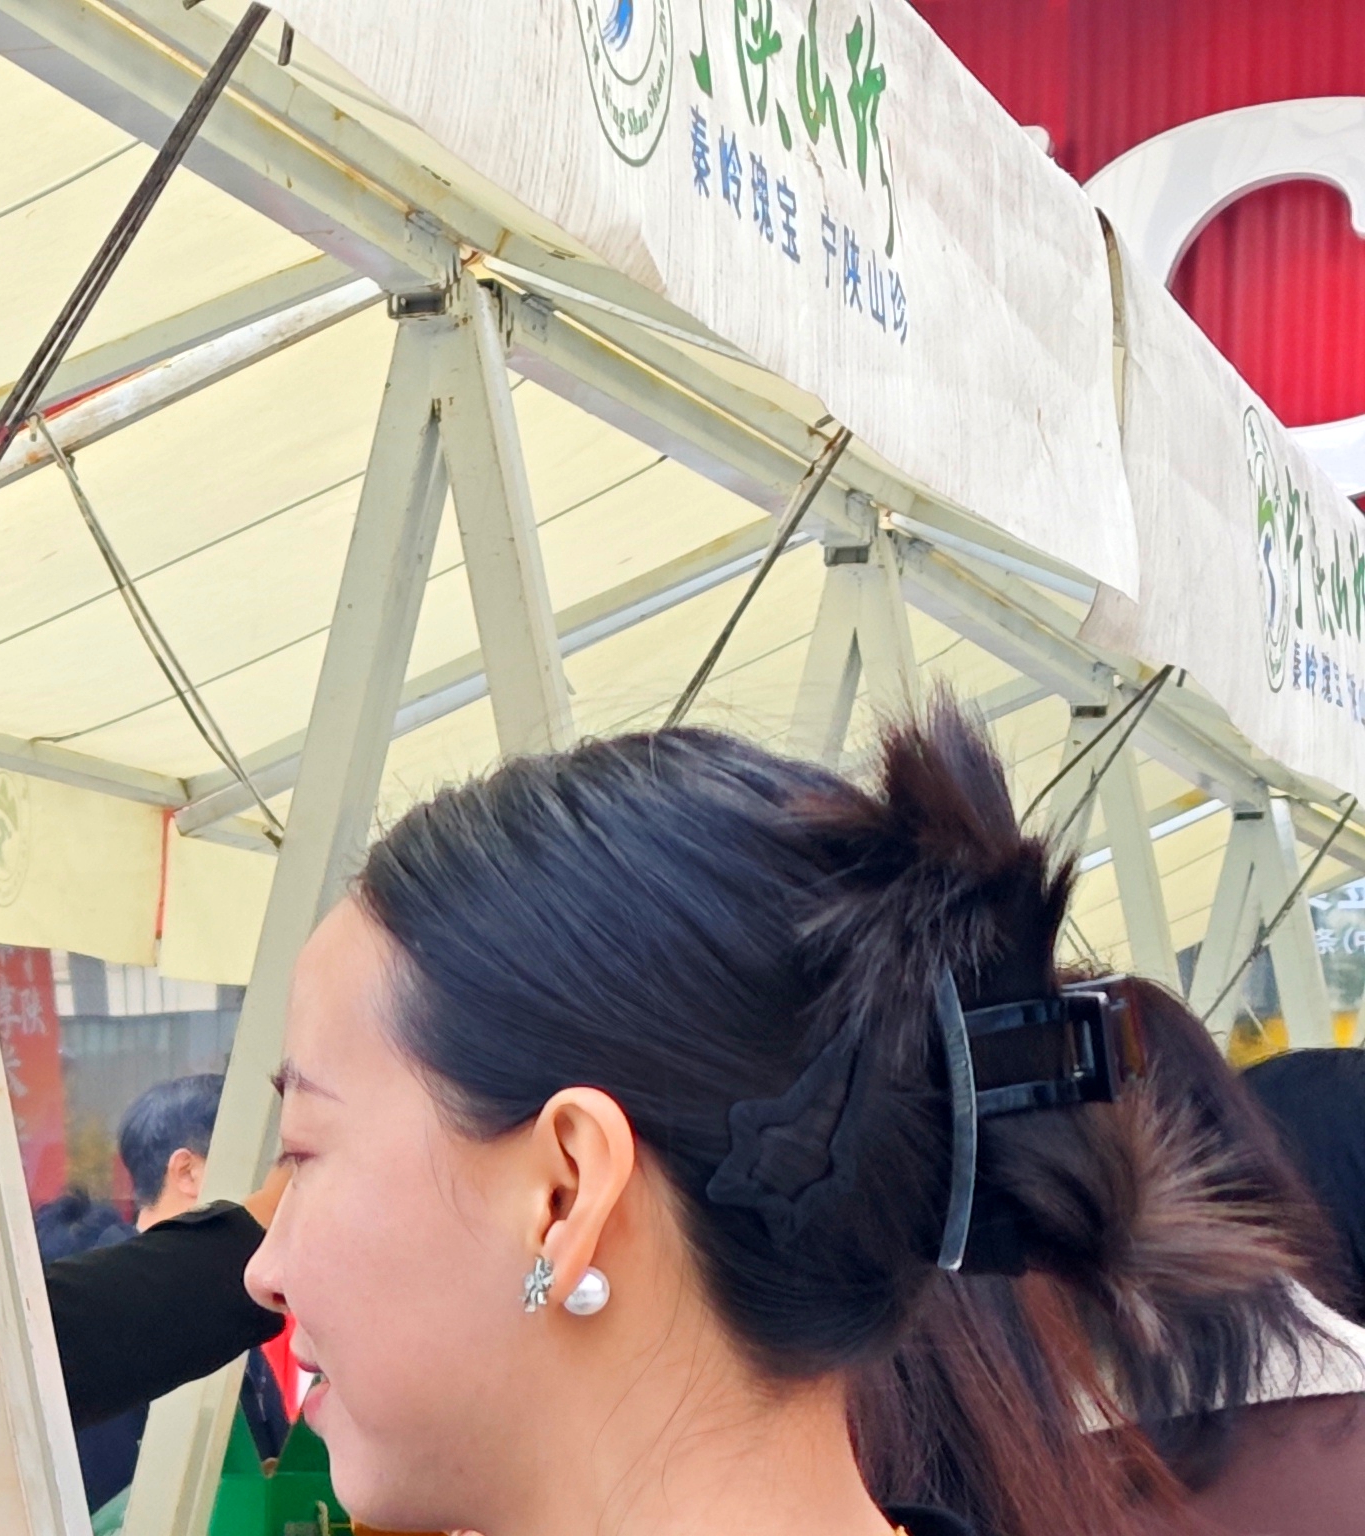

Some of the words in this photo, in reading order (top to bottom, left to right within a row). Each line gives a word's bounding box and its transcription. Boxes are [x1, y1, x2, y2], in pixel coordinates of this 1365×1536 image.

[690, 104, 801, 264] 秦岭瑰宝
[821, 205, 909, 345] 宁陕山珍
